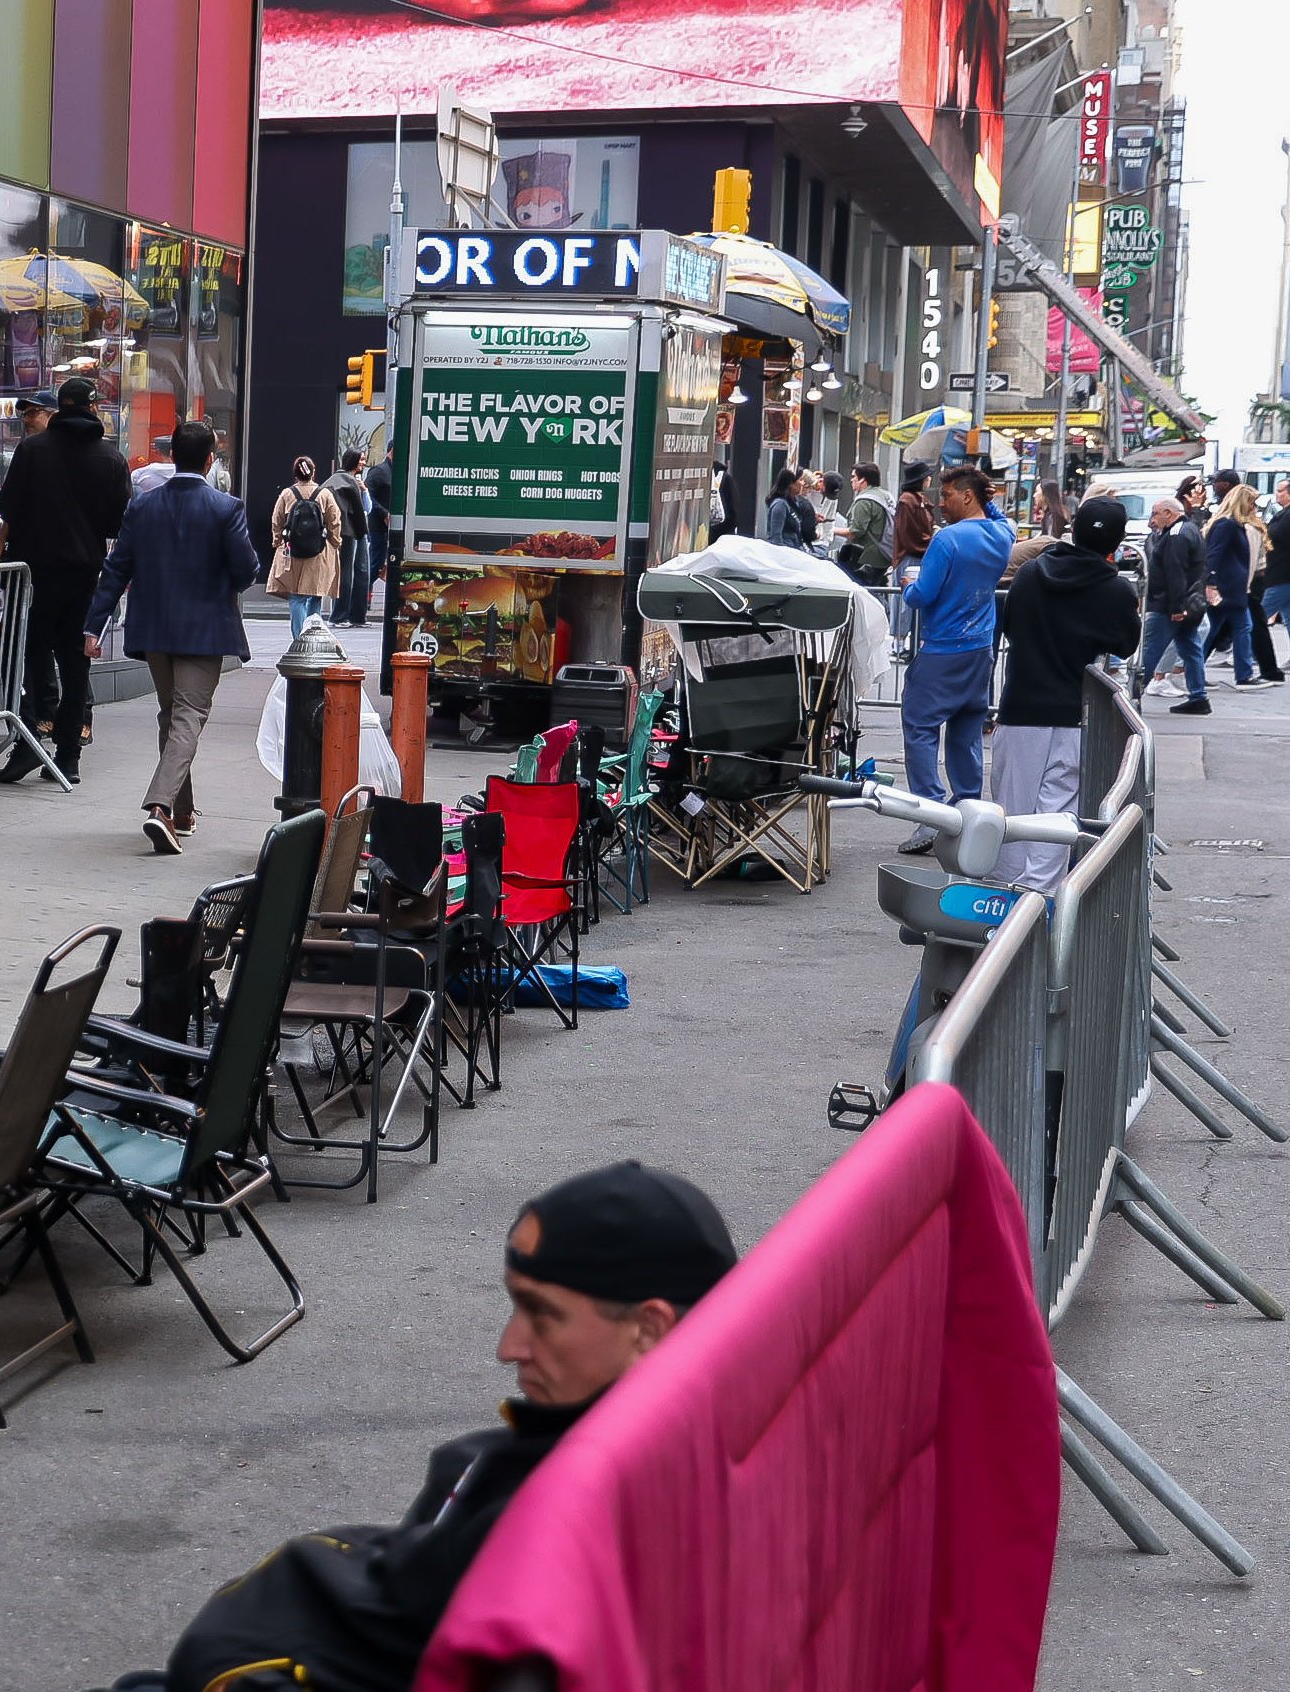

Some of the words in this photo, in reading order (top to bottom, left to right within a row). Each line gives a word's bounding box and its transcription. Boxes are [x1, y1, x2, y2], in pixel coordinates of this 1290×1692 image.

[1109, 209, 1146, 229] PUB
[415, 237, 494, 285] OR
[513, 238, 593, 286] OF
[470, 325, 590, 348] Nathan's
[919, 268, 943, 390] 1540
[423, 356, 463, 364] OPERATED
[475, 357, 489, 365] Y2J
[422, 392, 473, 412] THE
[479, 394, 581, 414] FLAVOR
[589, 396, 626, 415] OF
[420, 415, 510, 443] NEW
[420, 466, 469, 480] MOZZARELA
[470, 468, 500, 480] STICKS
[510, 469, 536, 481] ONION
[537, 470, 563, 482] RINGS
[580, 471, 598, 483] HOT
[599, 472, 621, 483] DOGS
[442, 484, 473, 497] CHEESE
[474, 486, 498, 498] FRIES
[520, 487, 543, 499] CORN
[545, 488, 563, 499] DOG
[564, 489, 603, 500] NUGGETS
[411, 641, 437, 656] 05
[972, 899, 1006, 917] citi
